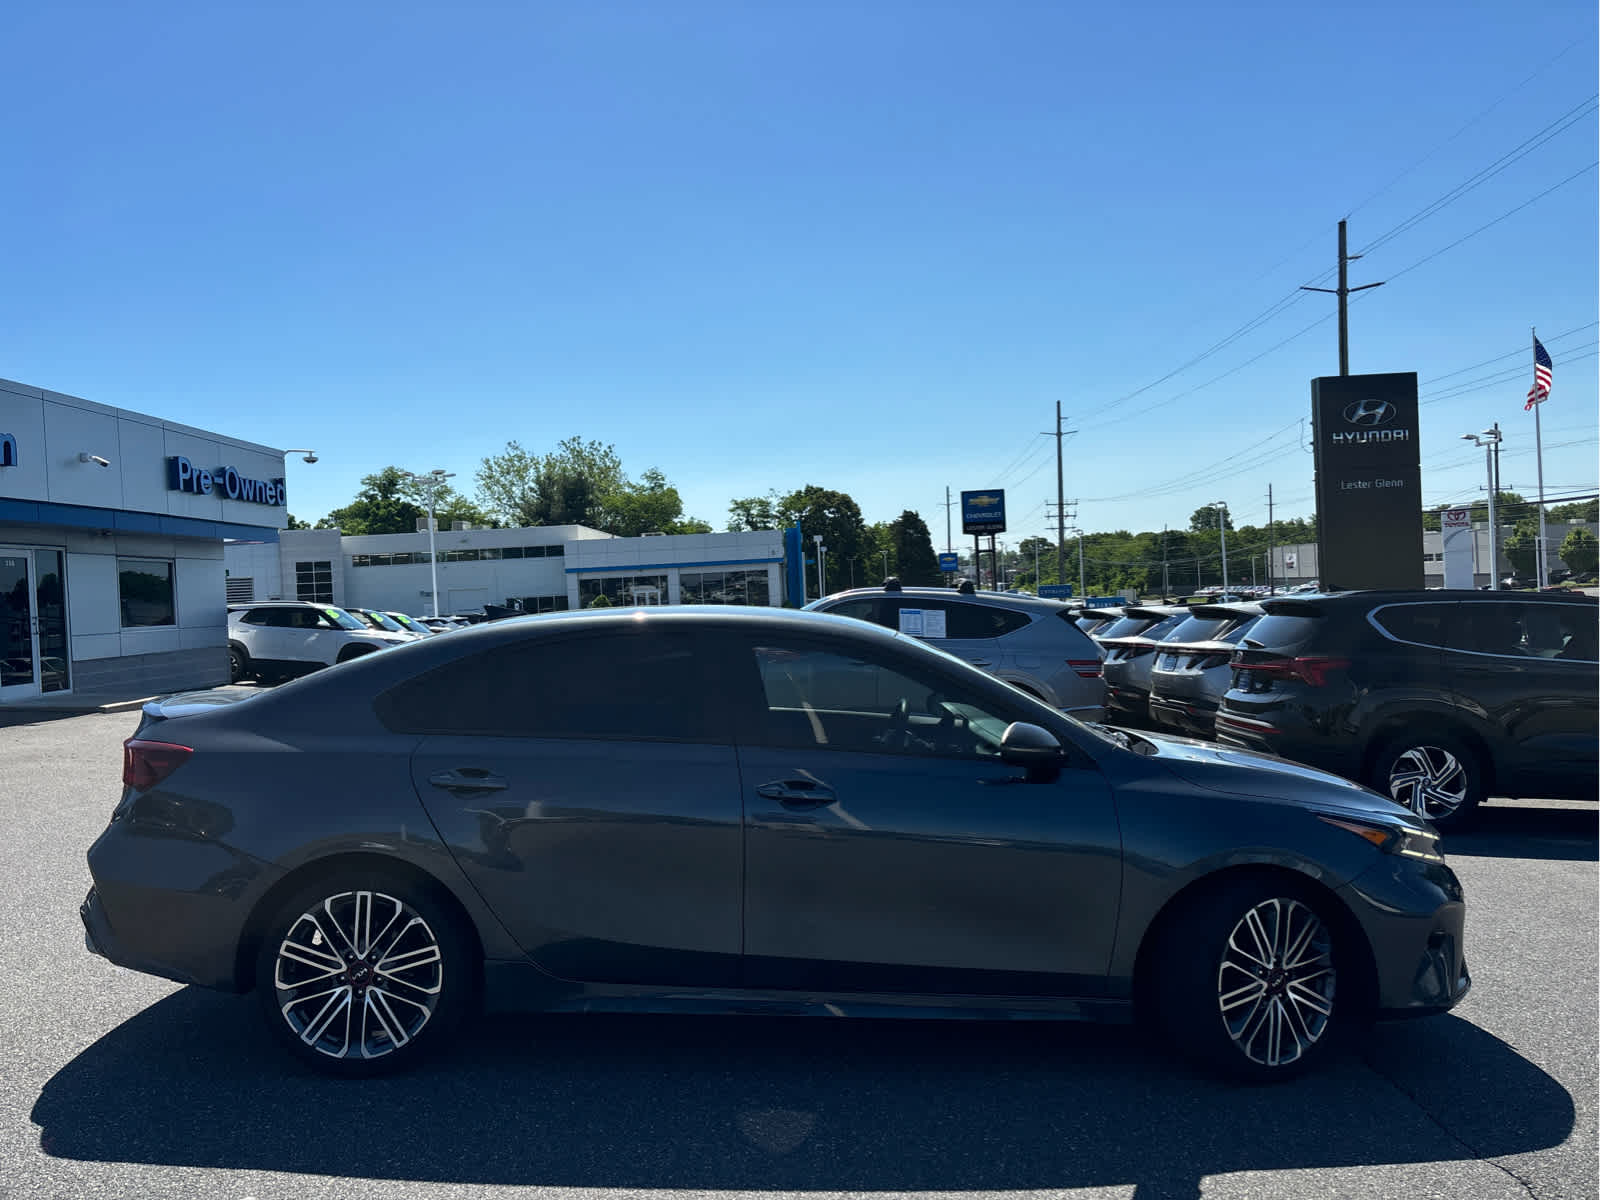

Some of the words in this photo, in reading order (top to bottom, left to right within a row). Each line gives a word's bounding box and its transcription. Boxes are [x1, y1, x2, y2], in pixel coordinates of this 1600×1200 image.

[1332, 429, 1409, 444] HYUNDAI
[173, 455, 286, 505] Pre-Owned
[1340, 479, 1372, 490] Lester
[1375, 479, 1404, 488] Glenn
